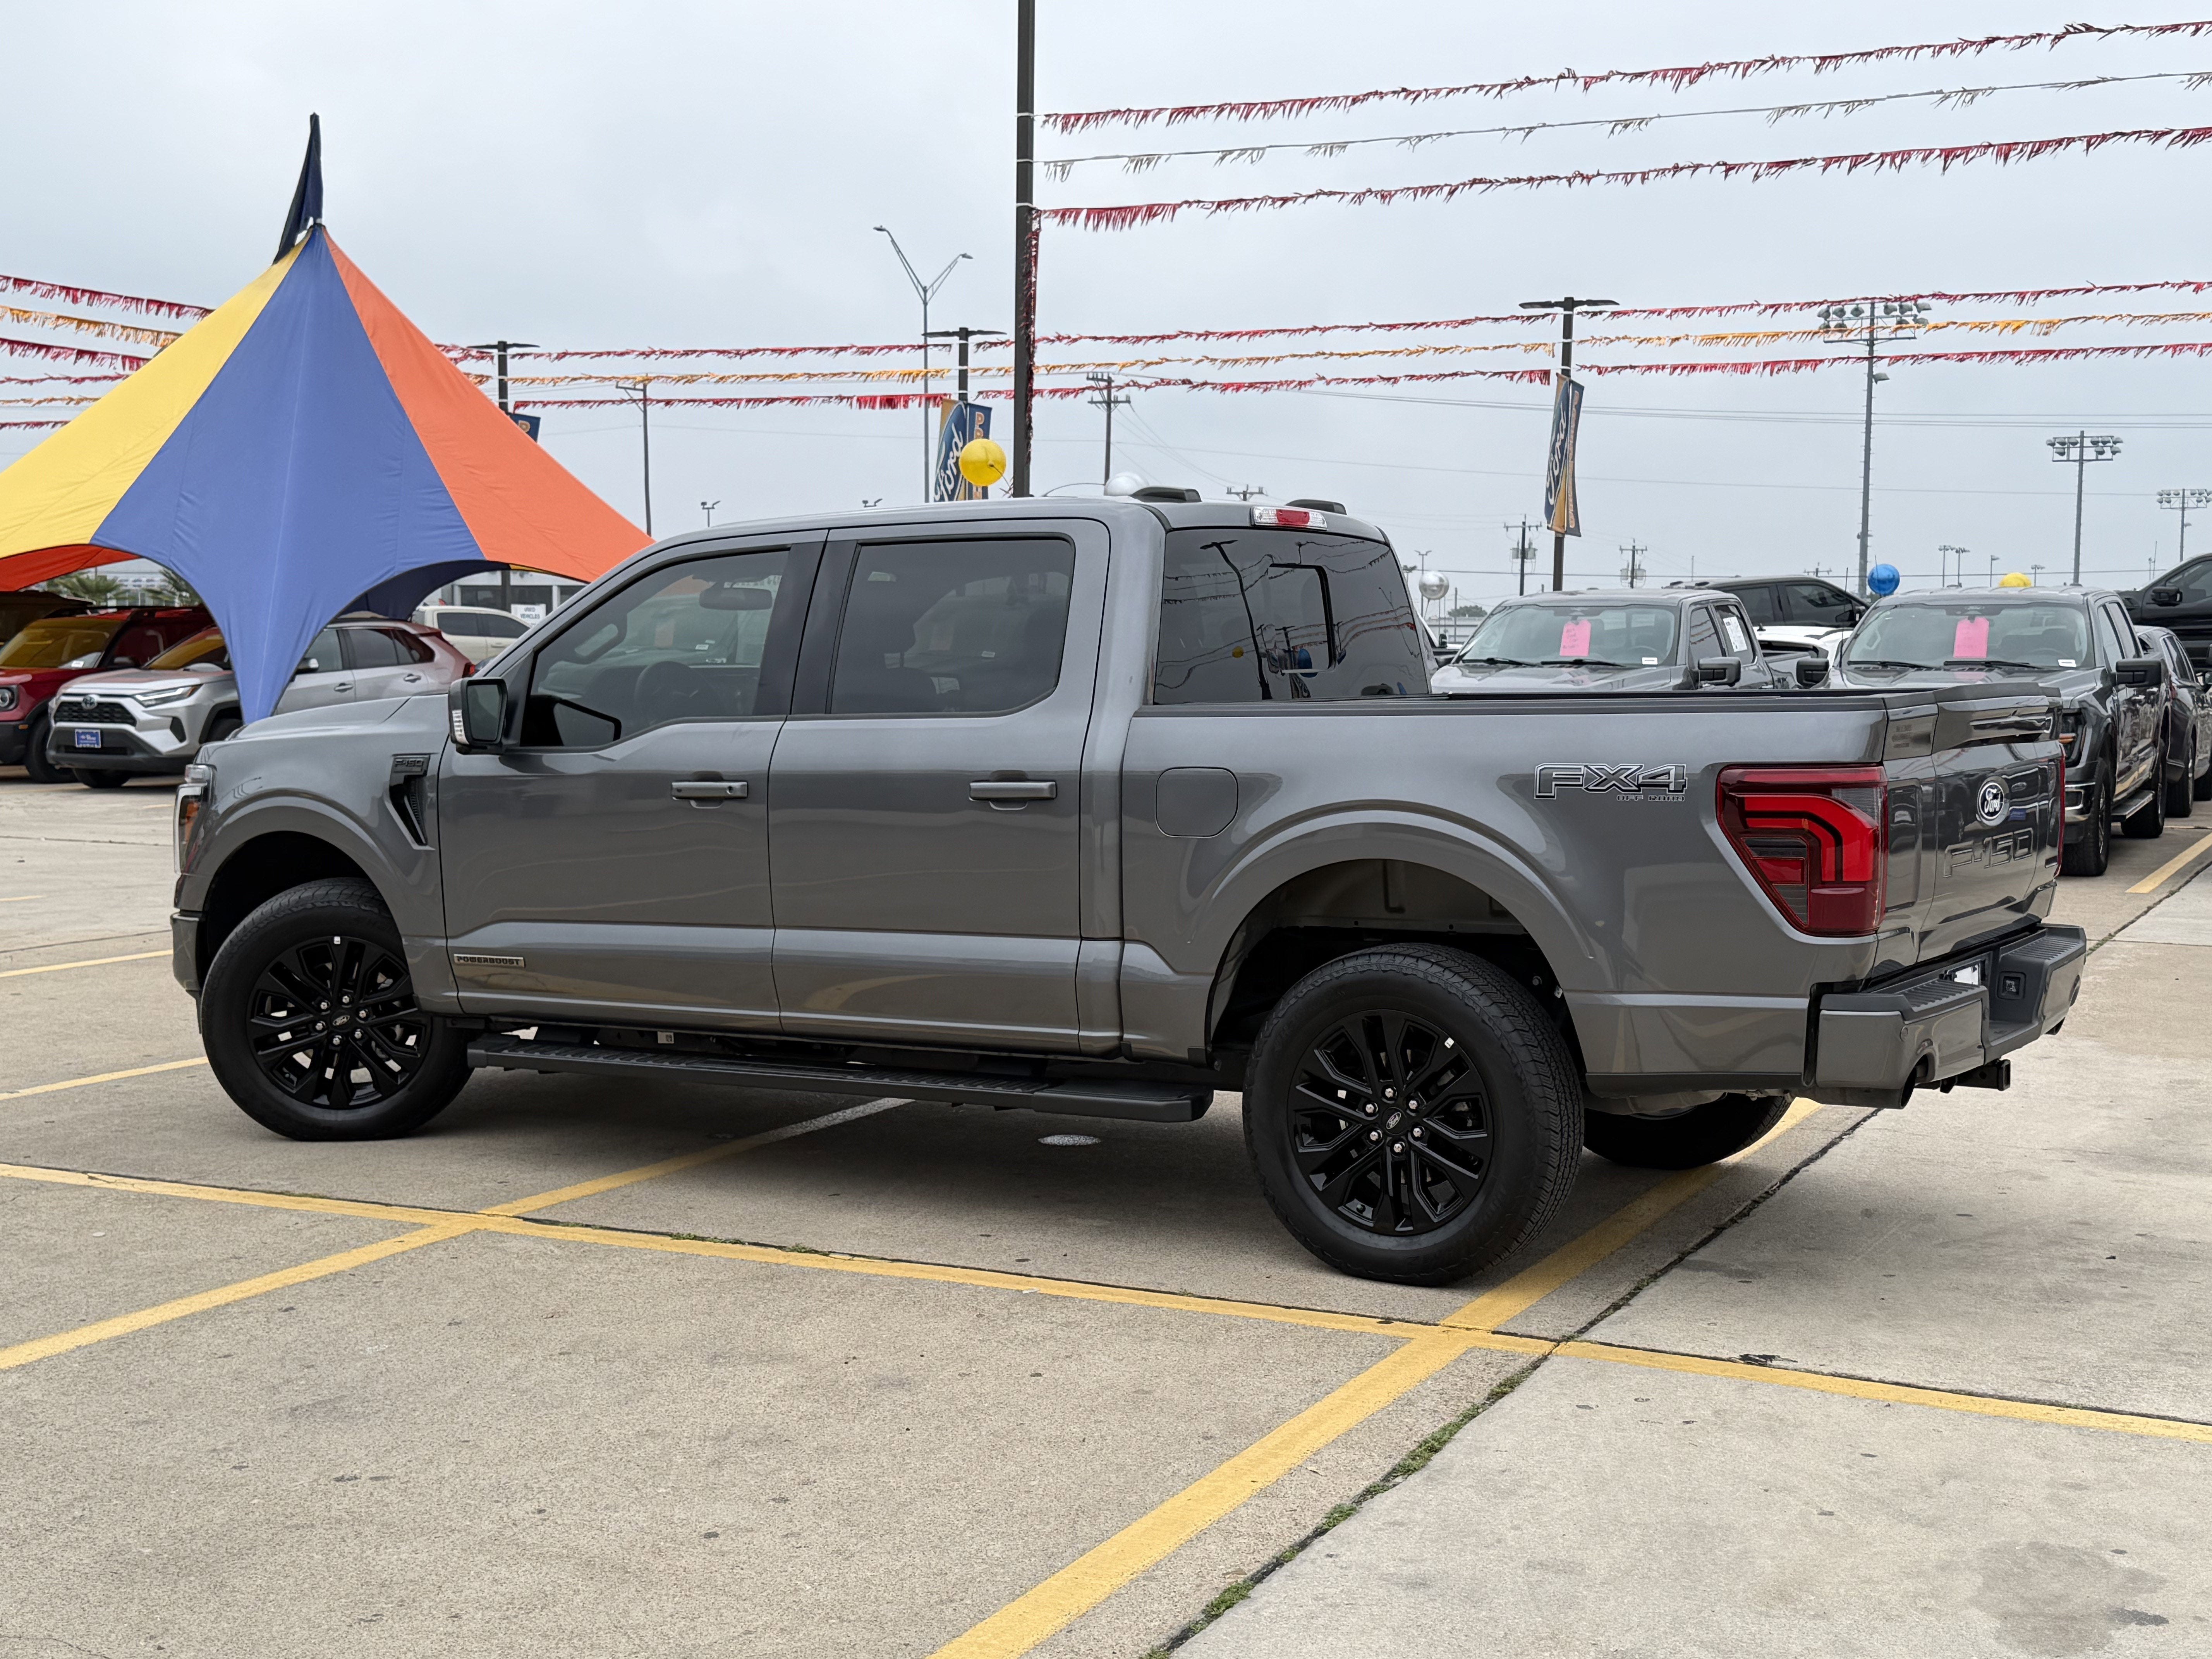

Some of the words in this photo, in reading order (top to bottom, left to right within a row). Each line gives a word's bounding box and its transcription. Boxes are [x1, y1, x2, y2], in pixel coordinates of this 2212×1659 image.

[934, 423, 963, 501] Ford
[1534, 763, 1688, 800] FX4
[1984, 788, 2001, 813] Ford
[1942, 827, 2033, 878] F-150
[456, 955, 520, 965] POWERBOOST
